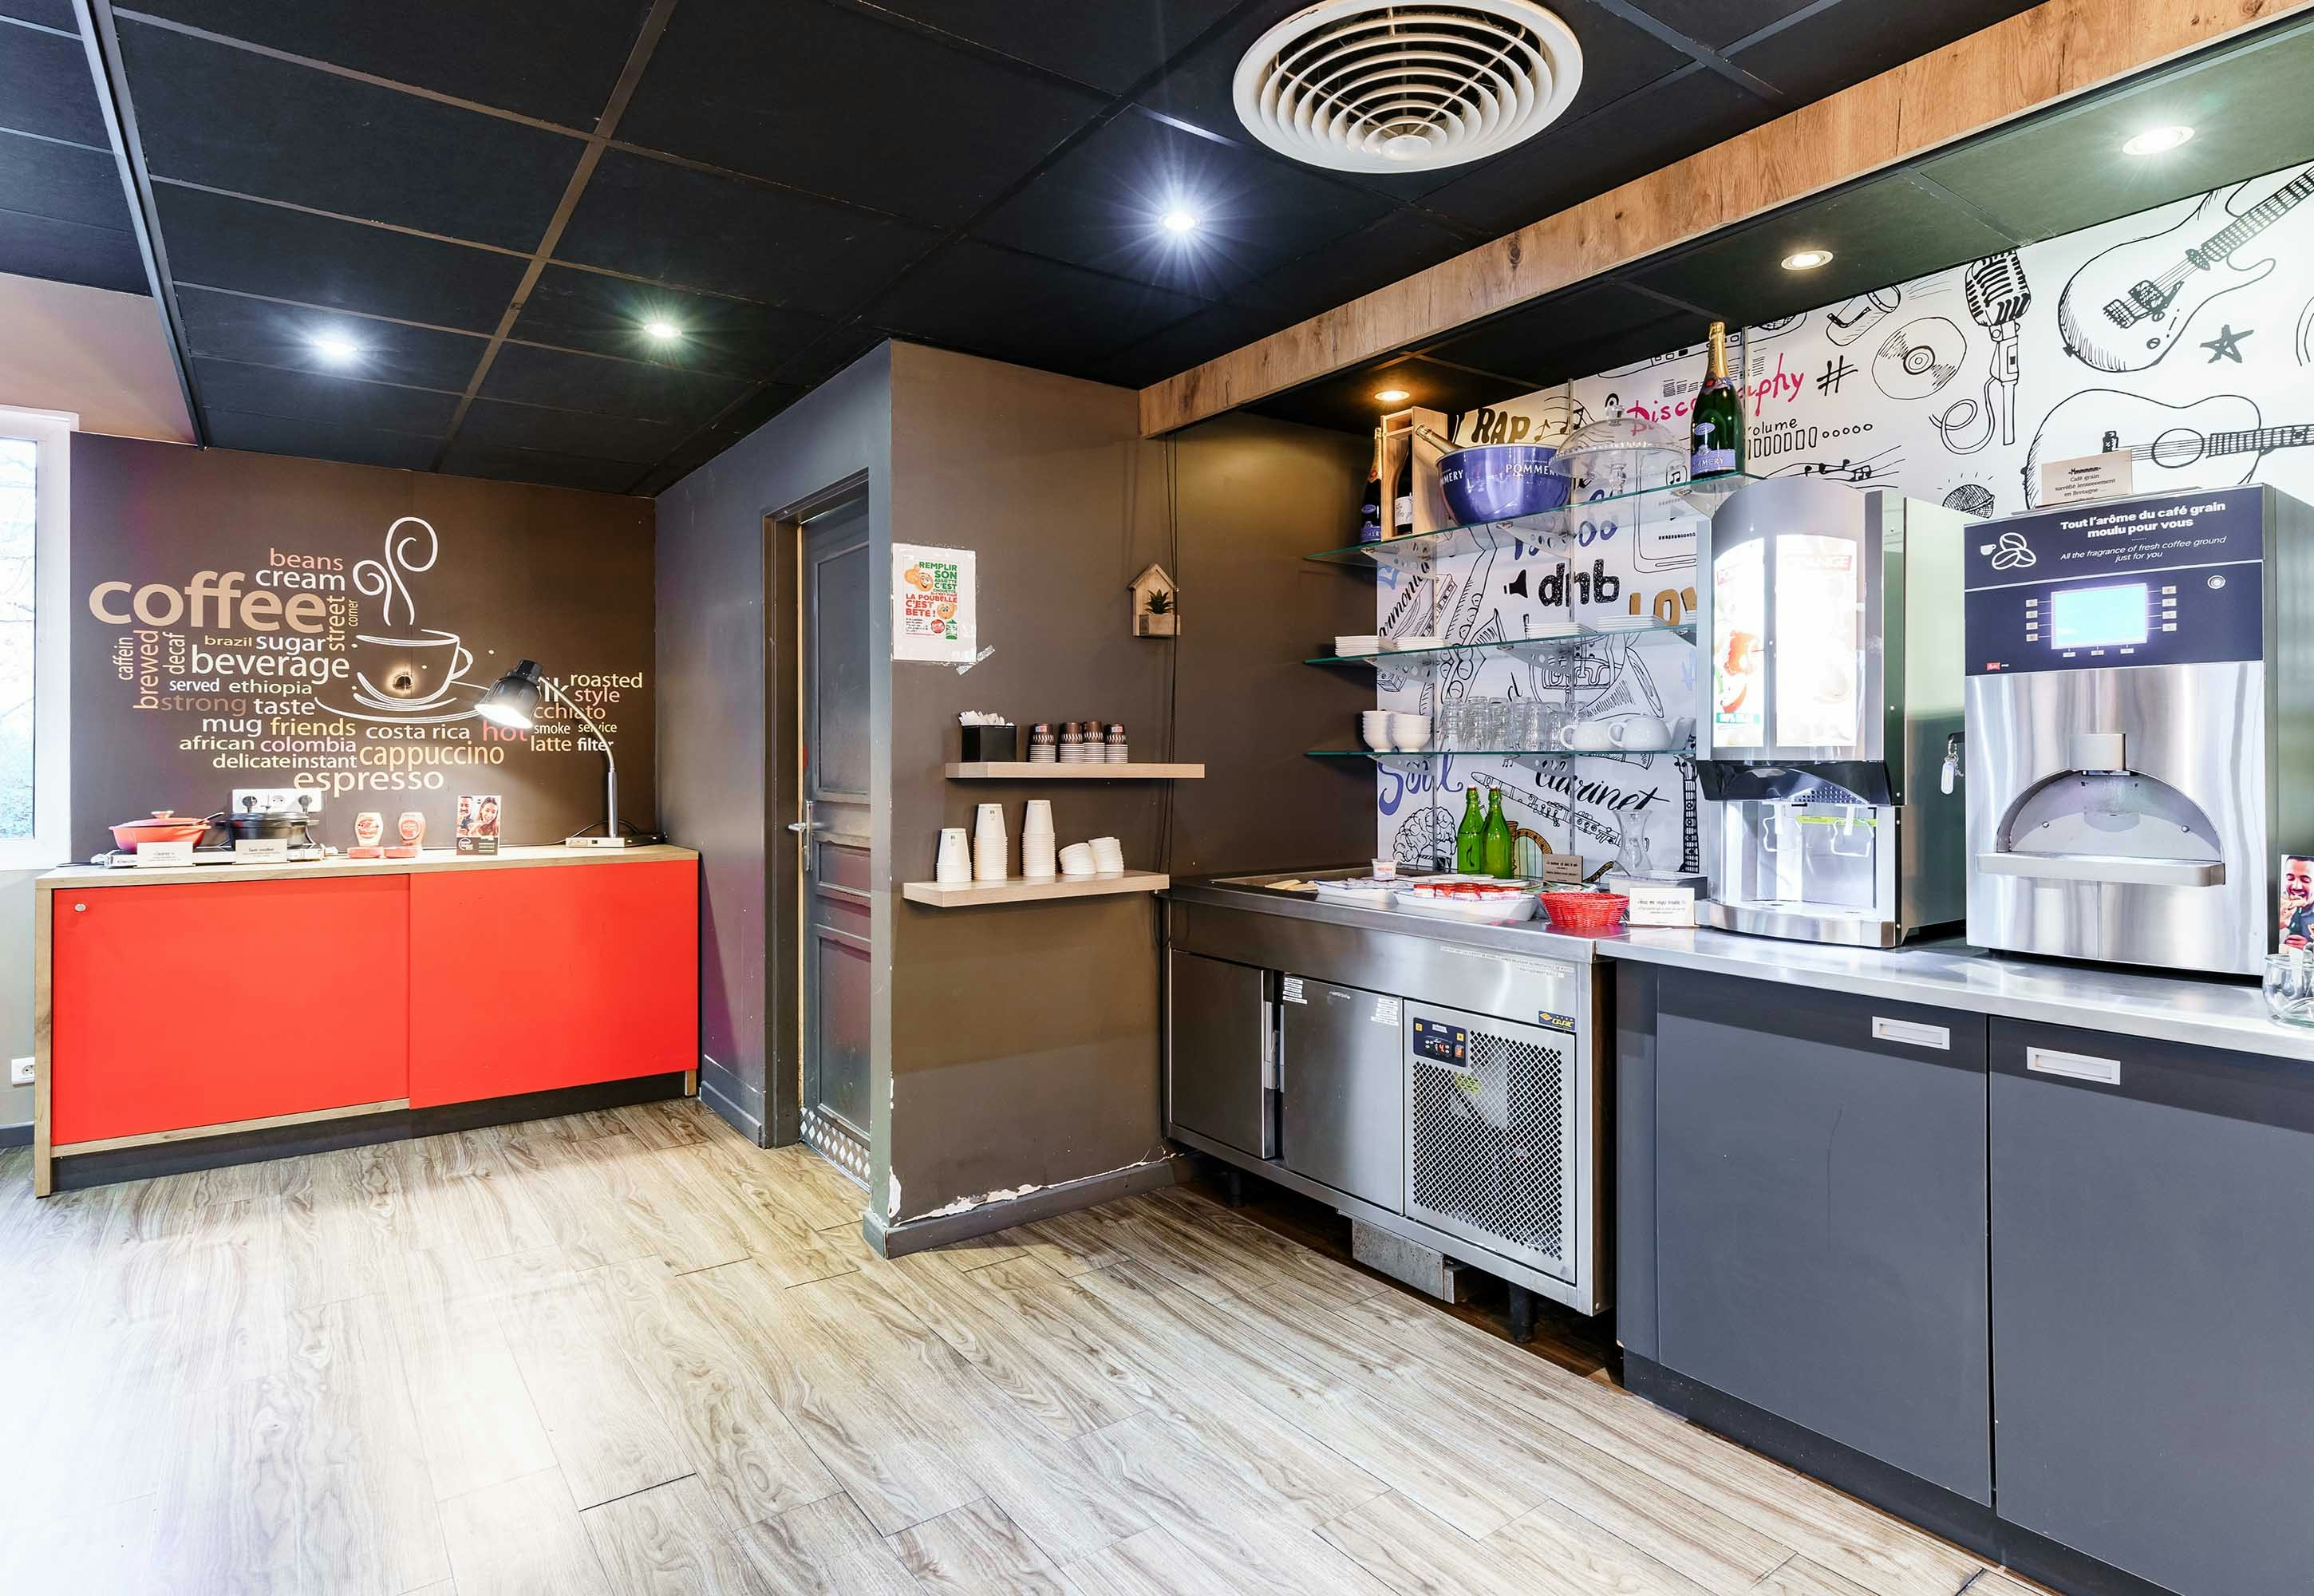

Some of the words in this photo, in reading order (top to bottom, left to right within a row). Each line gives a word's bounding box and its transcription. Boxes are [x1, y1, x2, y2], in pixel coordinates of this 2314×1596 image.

[1471, 408, 1531, 444] RAP
[1747, 417, 1798, 437] olume
[2060, 521, 2088, 530] Tout
[2089, 512, 2137, 527] l'arôme
[2138, 510, 2156, 520] du
[2157, 506, 2188, 518] café
[2190, 501, 2226, 516] grain
[2087, 525, 2126, 538] moulu
[2127, 523, 2158, 535] pour
[2160, 519, 2194, 529] vous
[2087, 547, 2126, 558] fragrance
[2138, 543, 2160, 551] fresh
[2162, 539, 2191, 549] coffee
[2193, 536, 2227, 547] ground
[2115, 554, 2132, 563] just
[2146, 551, 2164, 560] you
[270, 547, 344, 571] beans
[919, 561, 958, 571] REMPLIR
[255, 569, 346, 591] cream
[934, 570, 958, 580] SON
[89, 570, 326, 634] coffee
[906, 599, 934, 608] C'EST
[349, 599, 358, 626] corner
[328, 595, 346, 652] street
[204, 635, 252, 647] brazil
[256, 635, 326, 655] sugar
[112, 636, 133, 681] caffein
[163, 632, 185, 675] decaf
[133, 630, 159, 709] brewed
[192, 644, 350, 685] beverage
[169, 678, 220, 692] served
[228, 681, 313, 697] ethiopia
[570, 672, 642, 689] roasted
[575, 685, 621, 706] style
[160, 695, 247, 717] strong
[254, 697, 315, 716] taste
[203, 718, 263, 737] mug
[270, 717, 357, 737] friends
[365, 724, 425, 740] costa
[432, 723, 471, 740] rica
[534, 721, 571, 734] smoke
[179, 735, 255, 751] african
[260, 736, 357, 753] colombia
[531, 735, 572, 752] latte
[359, 741, 504, 772] cappuccino
[293, 771, 444, 798] espresso
